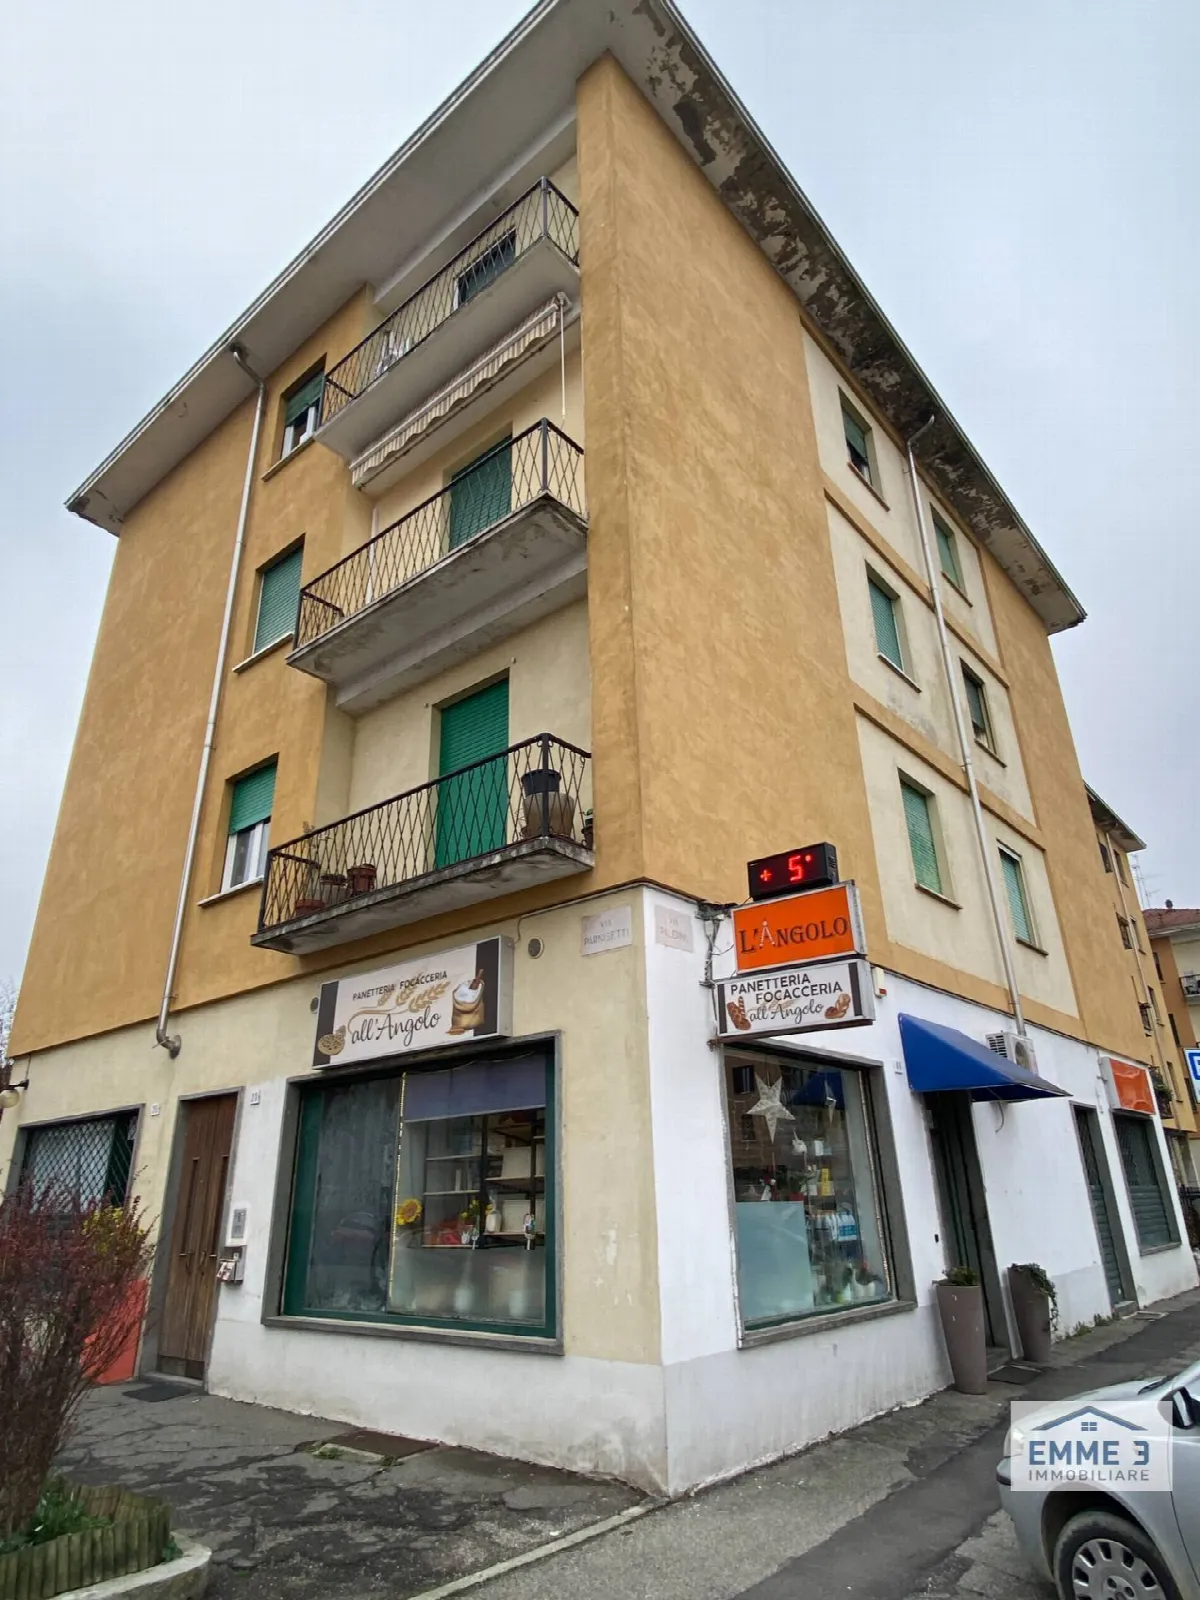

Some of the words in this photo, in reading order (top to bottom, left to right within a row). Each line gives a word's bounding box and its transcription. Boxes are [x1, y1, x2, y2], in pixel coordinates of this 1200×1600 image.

[739, 917, 848, 954] L'ANGOLO
[352, 983, 396, 1001] PANETTERIA
[399, 970, 448, 989] FOCACCERIA
[731, 973, 811, 995] PANETTERIA
[756, 981, 843, 1004] FOCACCERIA
[351, 1005, 441, 1047] all'Angolo
